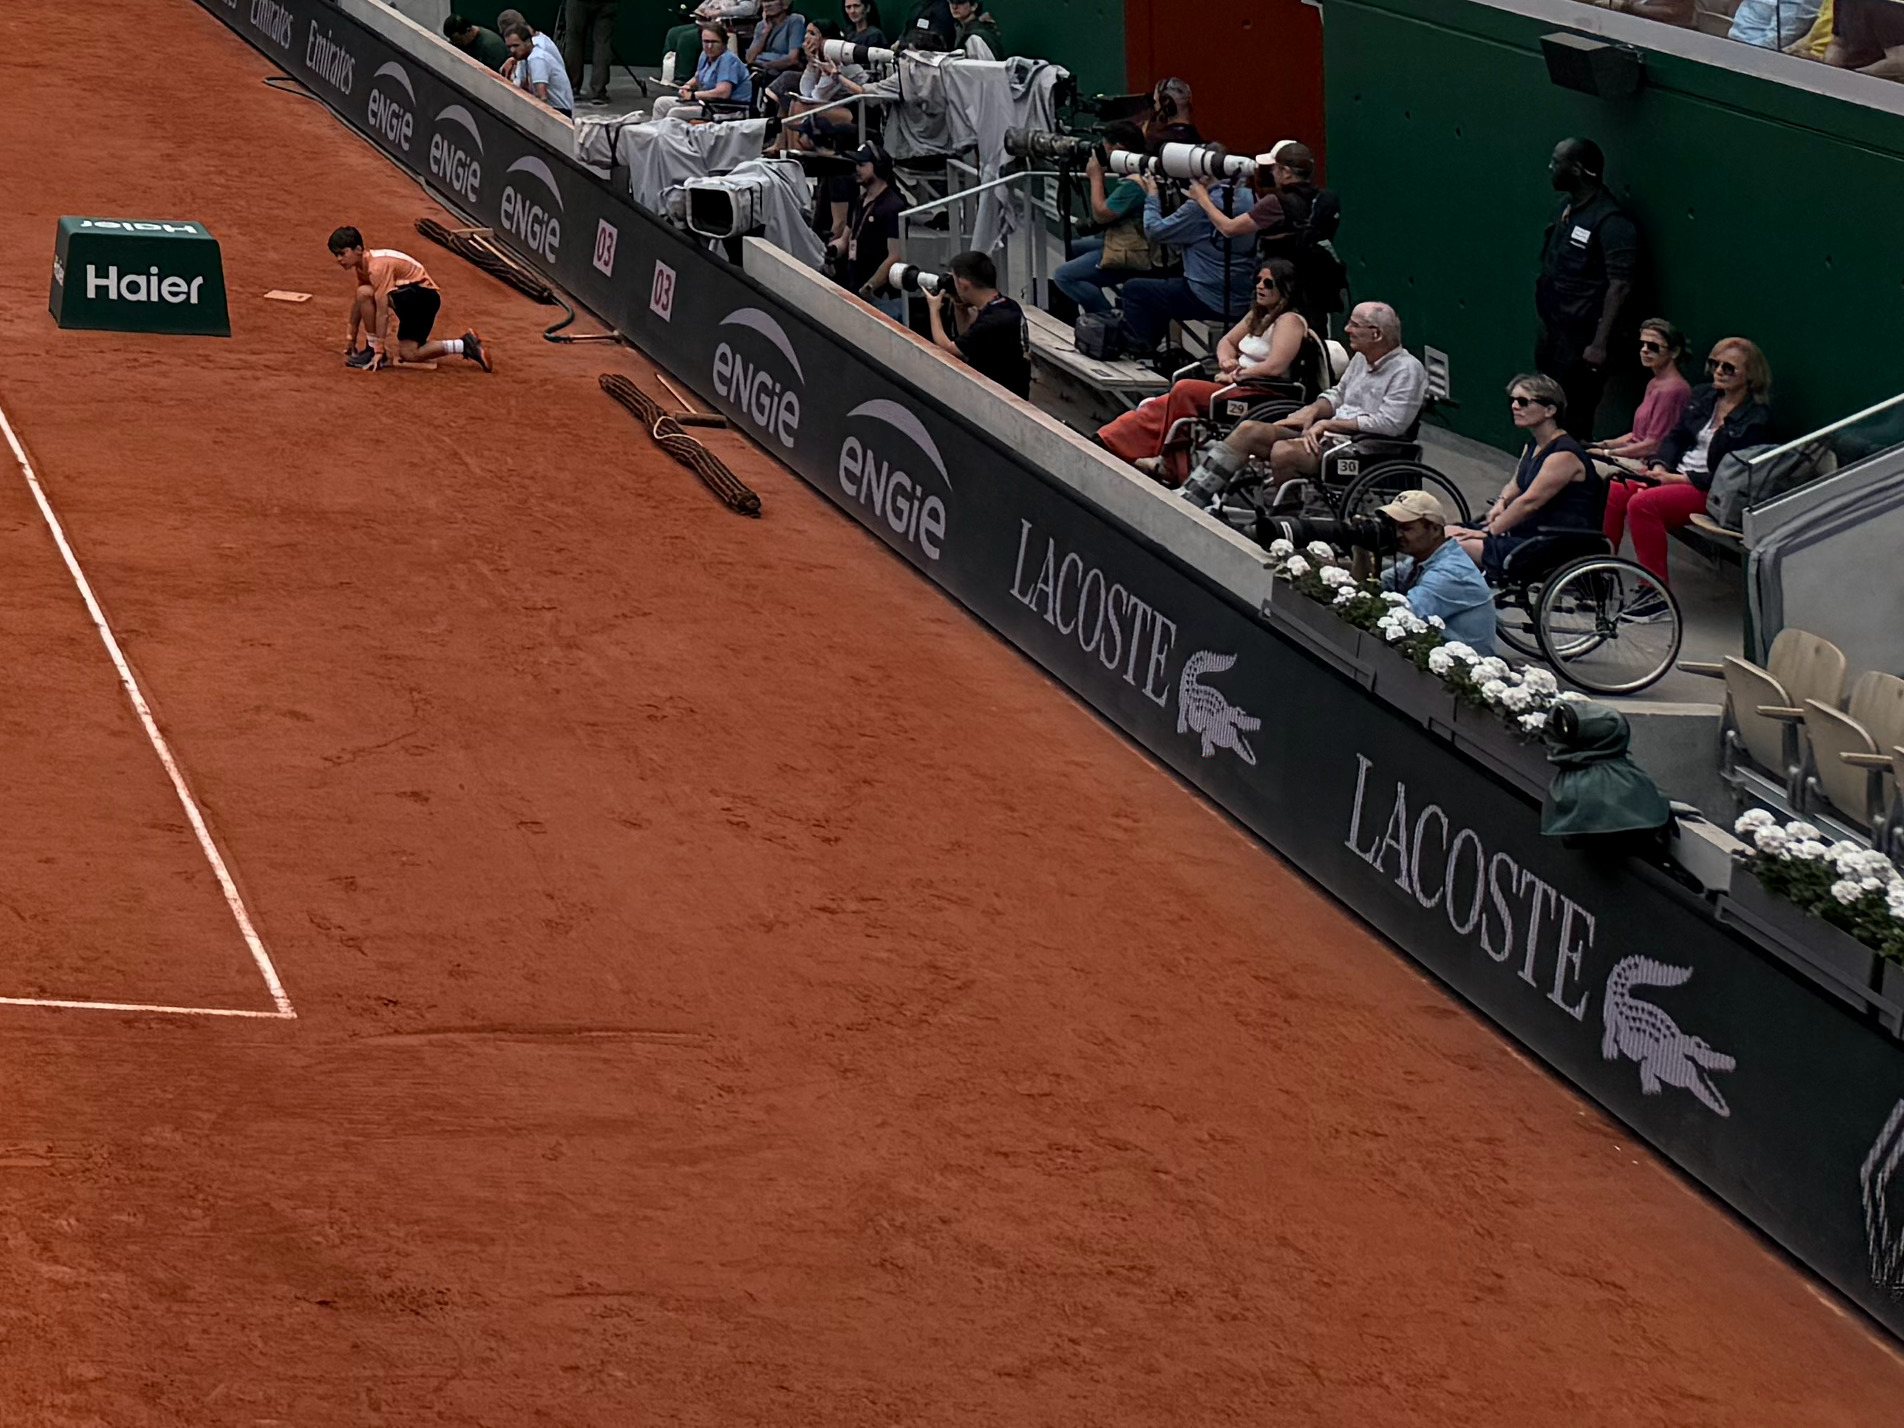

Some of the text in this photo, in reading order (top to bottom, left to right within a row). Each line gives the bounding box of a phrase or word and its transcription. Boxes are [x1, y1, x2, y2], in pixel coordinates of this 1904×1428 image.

[306, 19, 357, 96] Emirates
[595, 228, 615, 268] 03
[85, 264, 204, 305] Haier
[652, 273, 673, 313] 03
[1340, 461, 1357, 473] 30
[1009, 516, 1178, 708] LACOSTE
[1344, 751, 1596, 1024] LACOSTE
